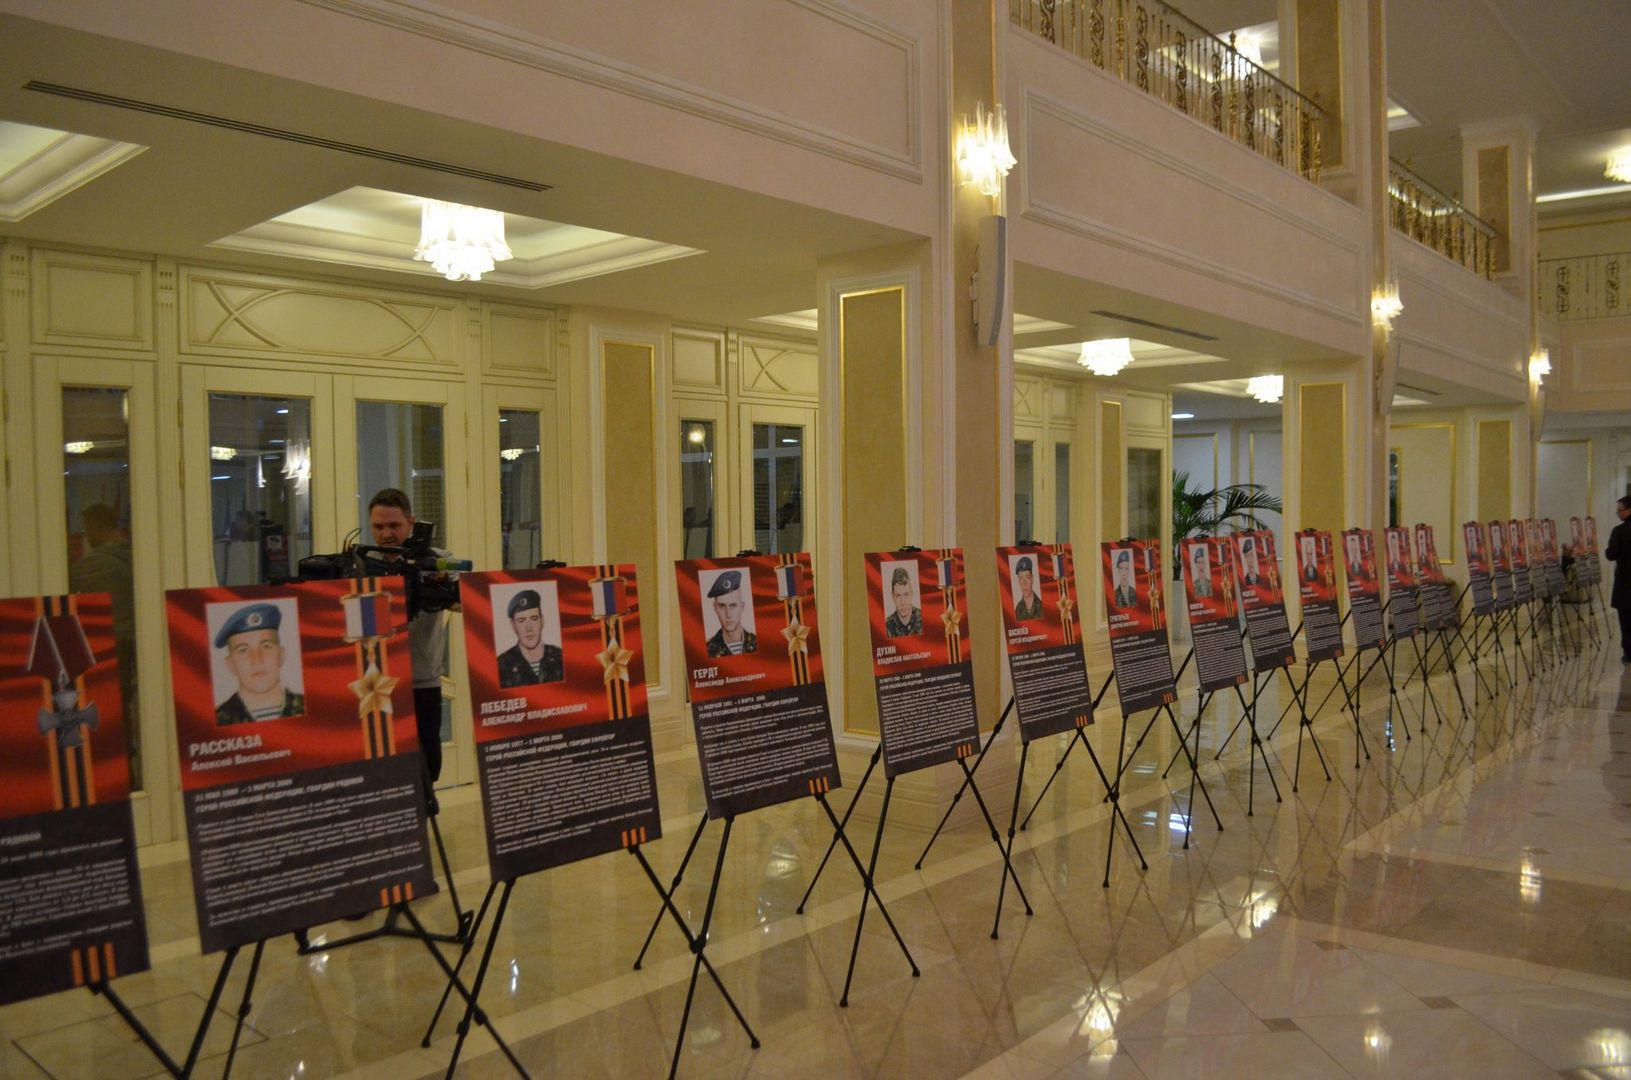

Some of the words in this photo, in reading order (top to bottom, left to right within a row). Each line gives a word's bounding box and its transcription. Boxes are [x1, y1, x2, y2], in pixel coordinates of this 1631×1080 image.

[876, 646, 896, 658] ДУХИН
[693, 666, 718, 679] ГЕРДТ
[481, 697, 527, 714] ЛЕБЕДЕВ
[482, 712, 525, 727] АЛЕКСАНДР
[527, 703, 588, 720] ВЛАДИСЛАВОВИЧ
[190, 734, 262, 758] РАССКАЗА
[192, 756, 232, 771] Алексей
[234, 749, 292, 765] Васильевич
